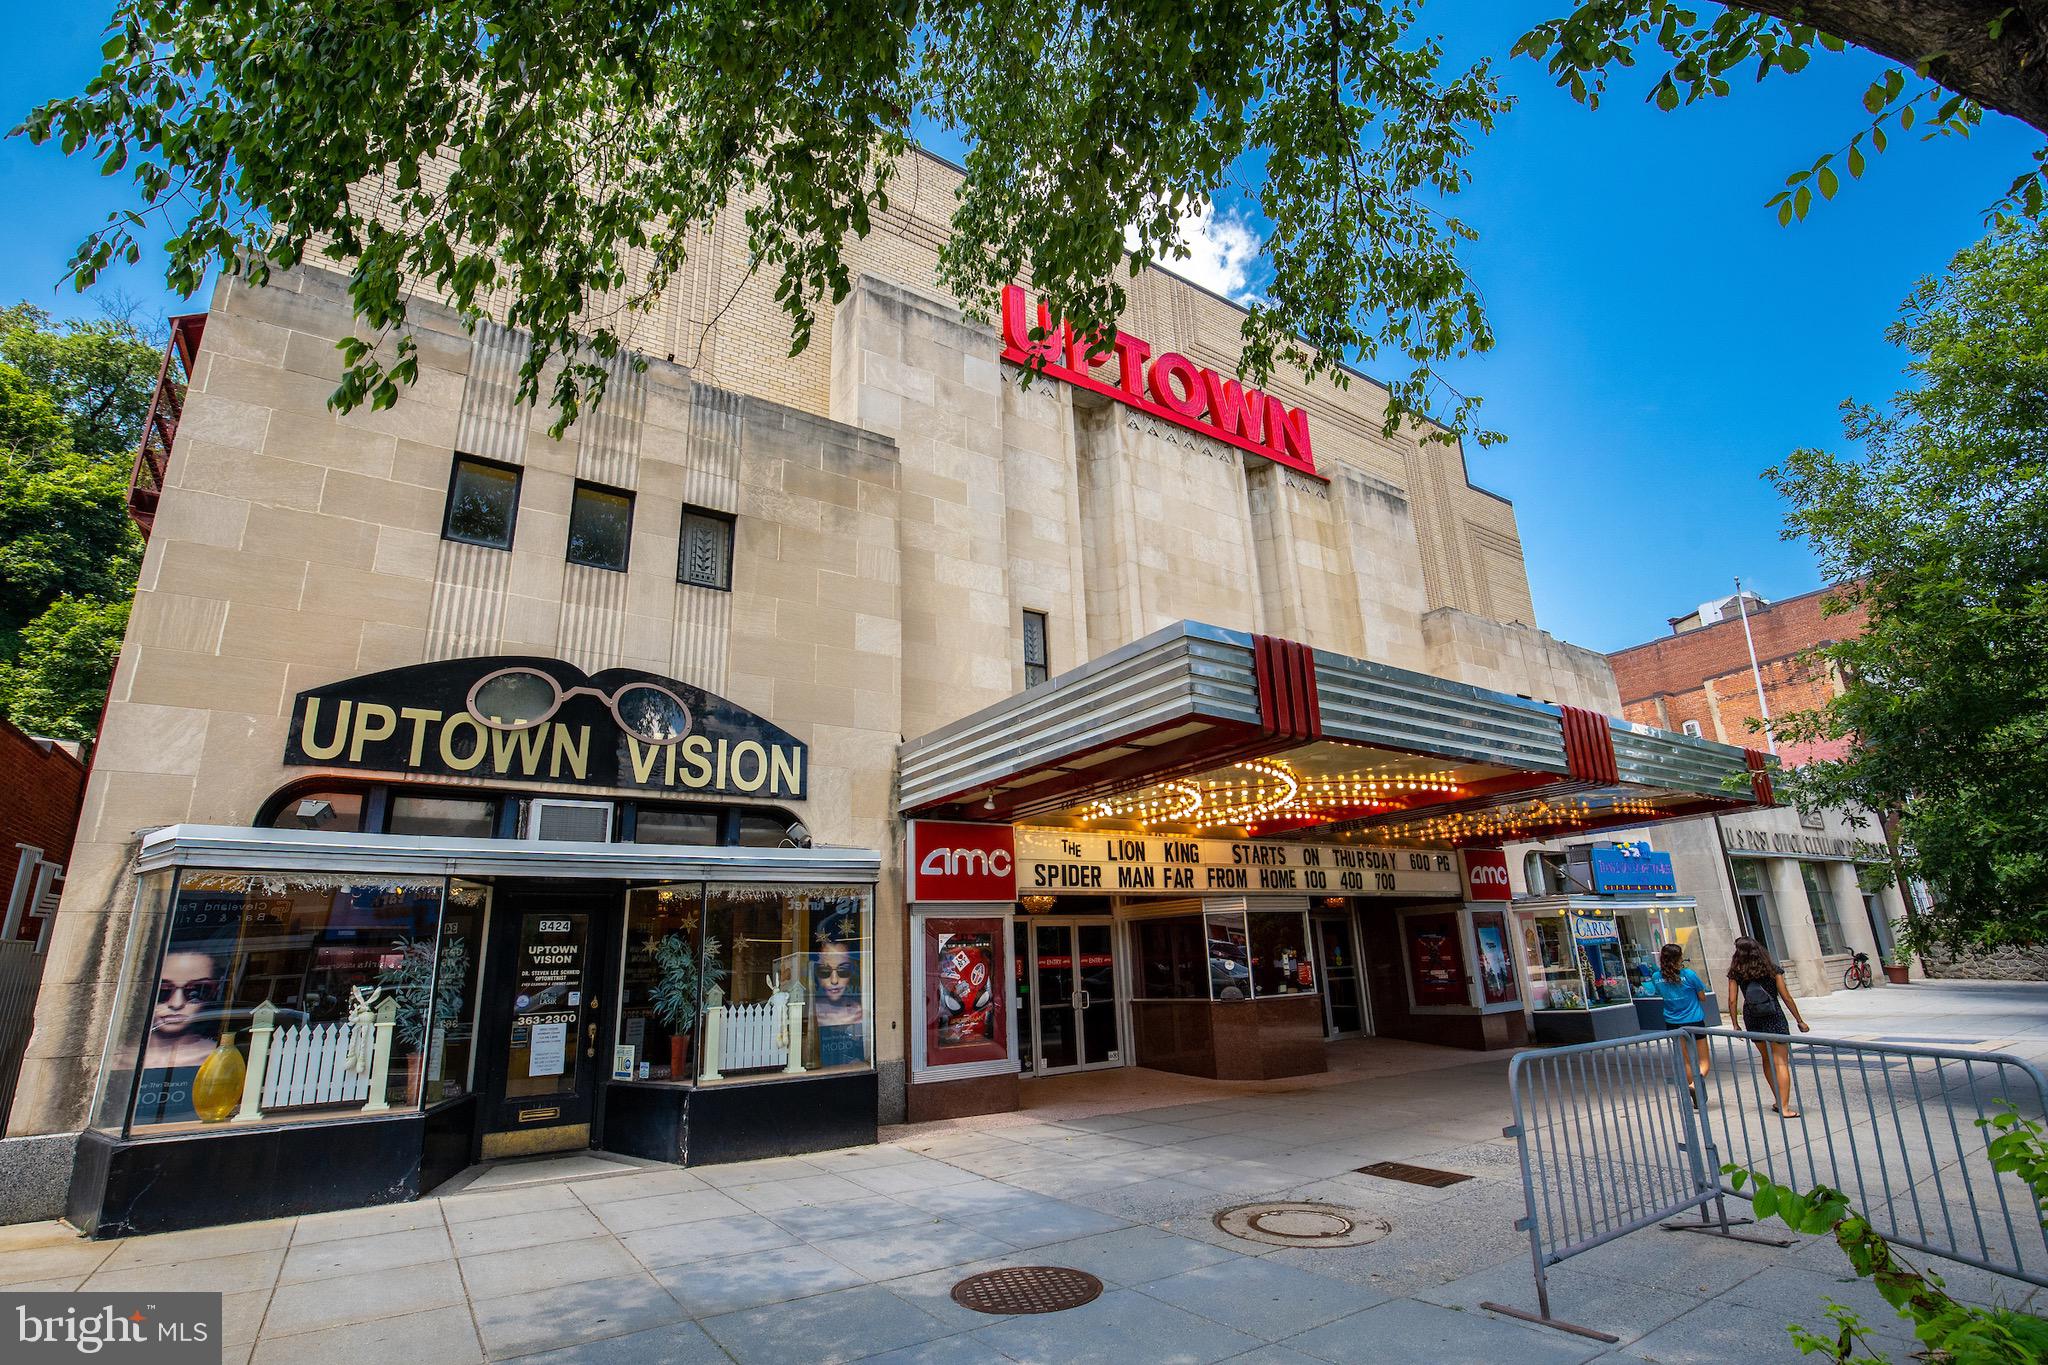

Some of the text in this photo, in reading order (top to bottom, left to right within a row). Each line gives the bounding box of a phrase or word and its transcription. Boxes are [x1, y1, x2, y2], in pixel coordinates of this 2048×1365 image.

[1001, 284, 1316, 472] UPTOWN
[301, 697, 801, 796] UPTOWN VISION
[1746, 830, 1770, 850] POST
[1061, 839, 1450, 872] THE LION KING STARTS ON THURSDAY 600 PG
[1035, 863, 1396, 891] SPIDER MAN FAR FROM HOME 100 400 700
[541, 921, 569, 931] 3424
[528, 945, 578, 955] UPTOWN
[533, 955, 572, 964] VISION
[518, 1014, 577, 1025] 363-2300
[141, 1090, 186, 1105] ODO
